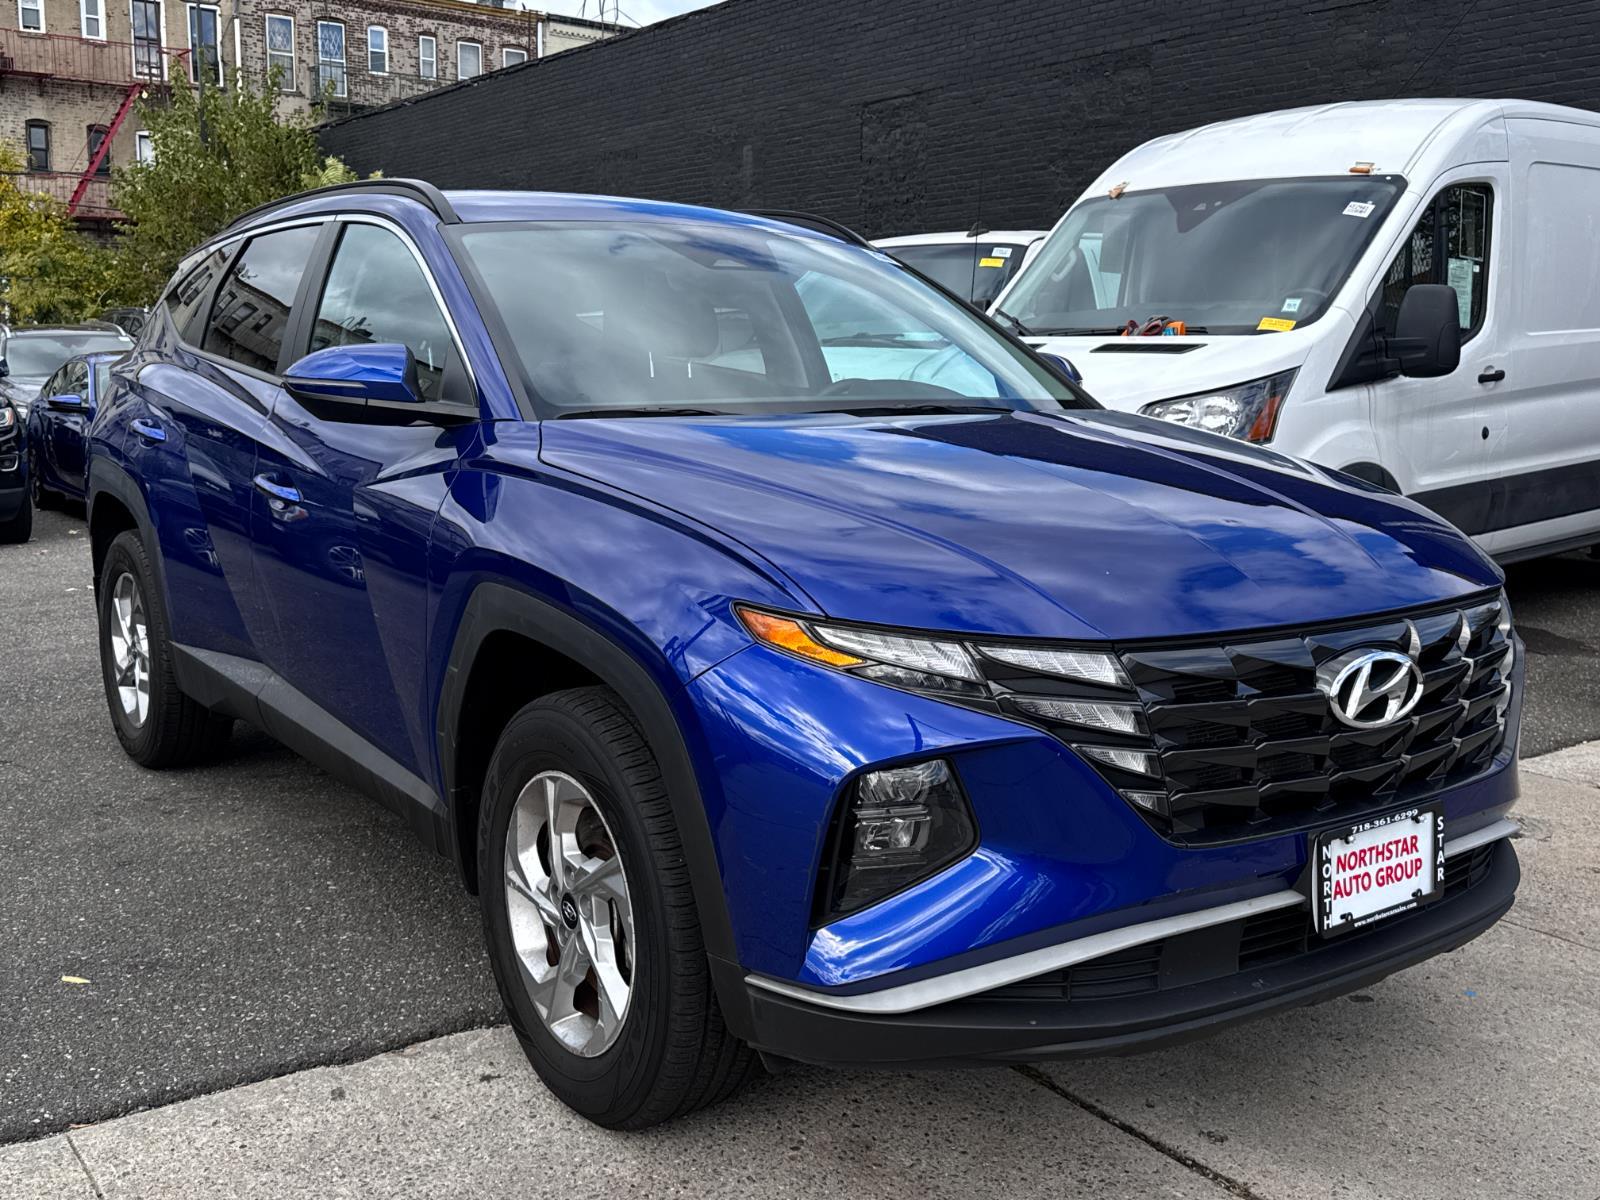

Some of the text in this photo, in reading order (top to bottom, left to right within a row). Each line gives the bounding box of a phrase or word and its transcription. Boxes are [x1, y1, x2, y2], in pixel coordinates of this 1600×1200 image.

[1351, 809, 1418, 834] 718-361-6299
[1336, 834, 1419, 874] NORTHSTAR
[1436, 816, 1445, 882] STAR
[1322, 845, 1333, 931] NORTH
[1333, 857, 1423, 901] AUTO GROUP
